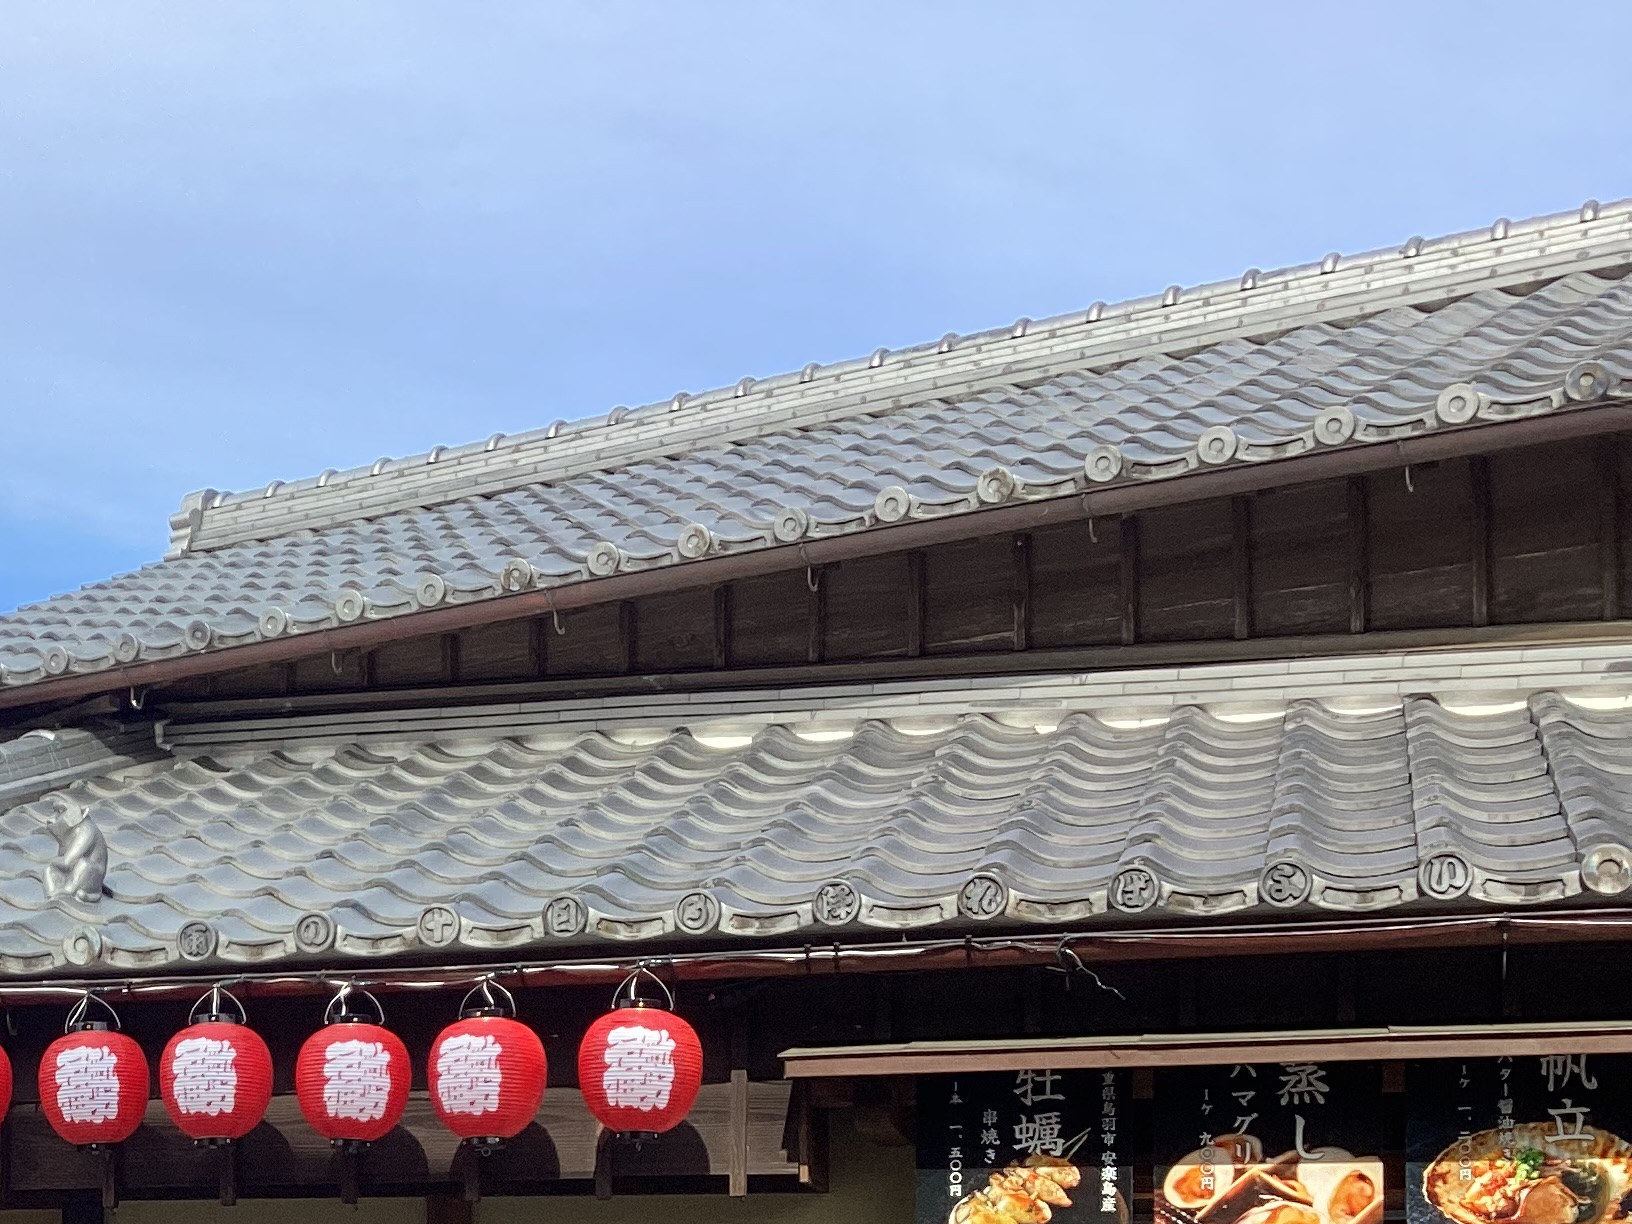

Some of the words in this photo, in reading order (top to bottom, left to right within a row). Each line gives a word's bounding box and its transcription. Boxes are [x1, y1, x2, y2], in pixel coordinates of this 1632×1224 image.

[425, 909, 453, 942] 十
[980, 1108, 1000, 1164] 串焼き
[1012, 1069, 1066, 1157] 牡蠣
[1230, 1065, 1259, 1165] ハマグリ
[1275, 1062, 1330, 1160] 蒸し
[1540, 1054, 1598, 1143] 帆立
[1101, 1151, 1117, 1213] 安楽島産
